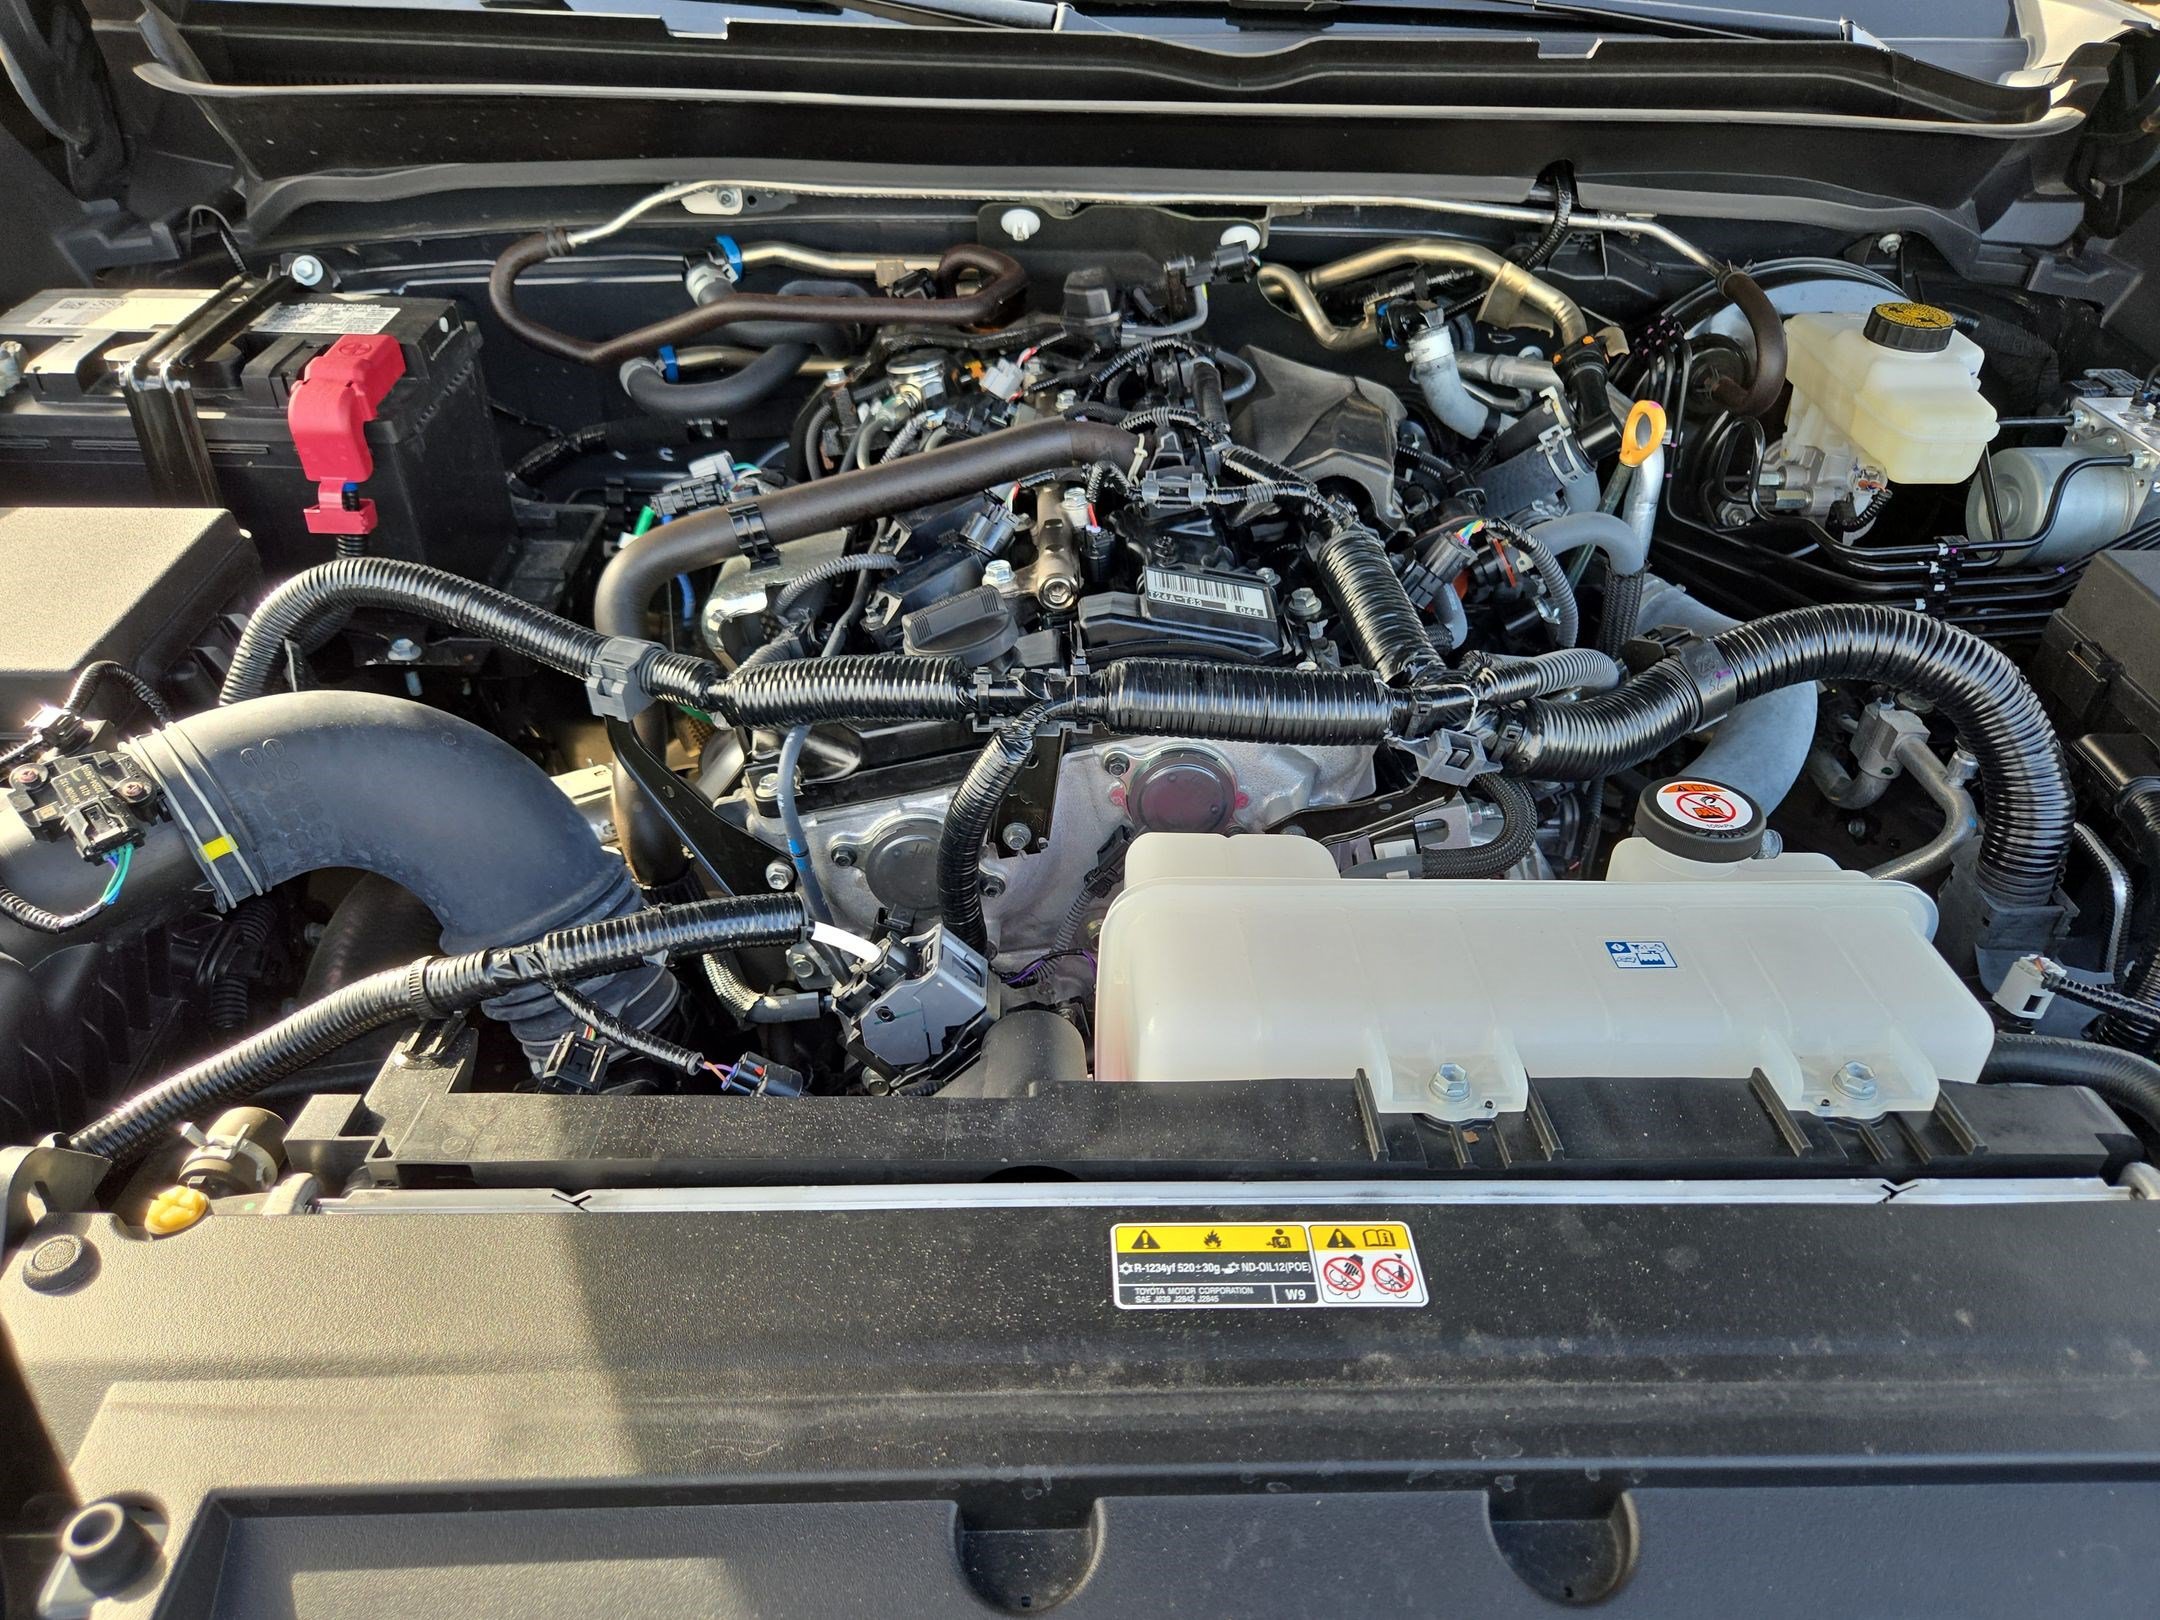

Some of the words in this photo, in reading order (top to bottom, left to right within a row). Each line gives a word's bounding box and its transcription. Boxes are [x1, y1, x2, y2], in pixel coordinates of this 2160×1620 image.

[1134, 1263, 1176, 1275] R-1234yf
[1177, 1263, 1221, 1275] 520±30g
[1241, 1262, 1312, 1274] ND-OIL12(POE)
[1134, 1287, 1166, 1295] TOYOTA
[1167, 1287, 1197, 1295] MOTOR
[1198, 1286, 1254, 1295] CORPORATION
[1285, 1289, 1307, 1301] W9
[1135, 1296, 1152, 1304] SAE
